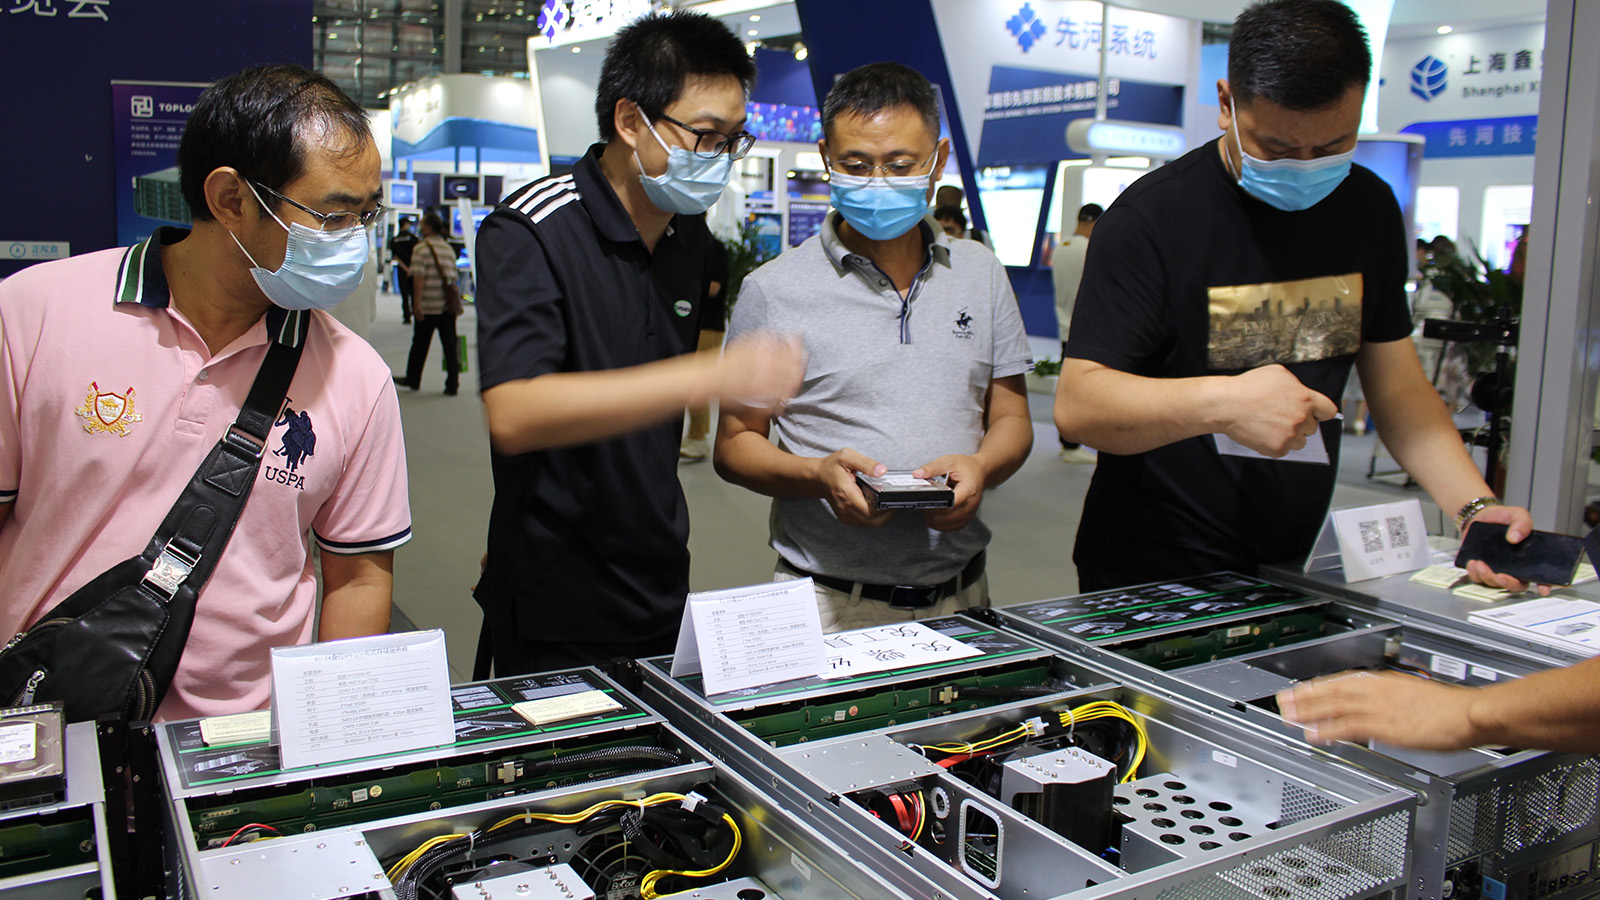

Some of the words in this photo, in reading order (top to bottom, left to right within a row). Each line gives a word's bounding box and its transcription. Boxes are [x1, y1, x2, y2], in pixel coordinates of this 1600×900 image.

[1055, 16, 1157, 59] 先河系统
[1462, 49, 1543, 75] 上海鑫
[1461, 81, 1525, 98] Shanghai
[264, 466, 305, 491] USPA
